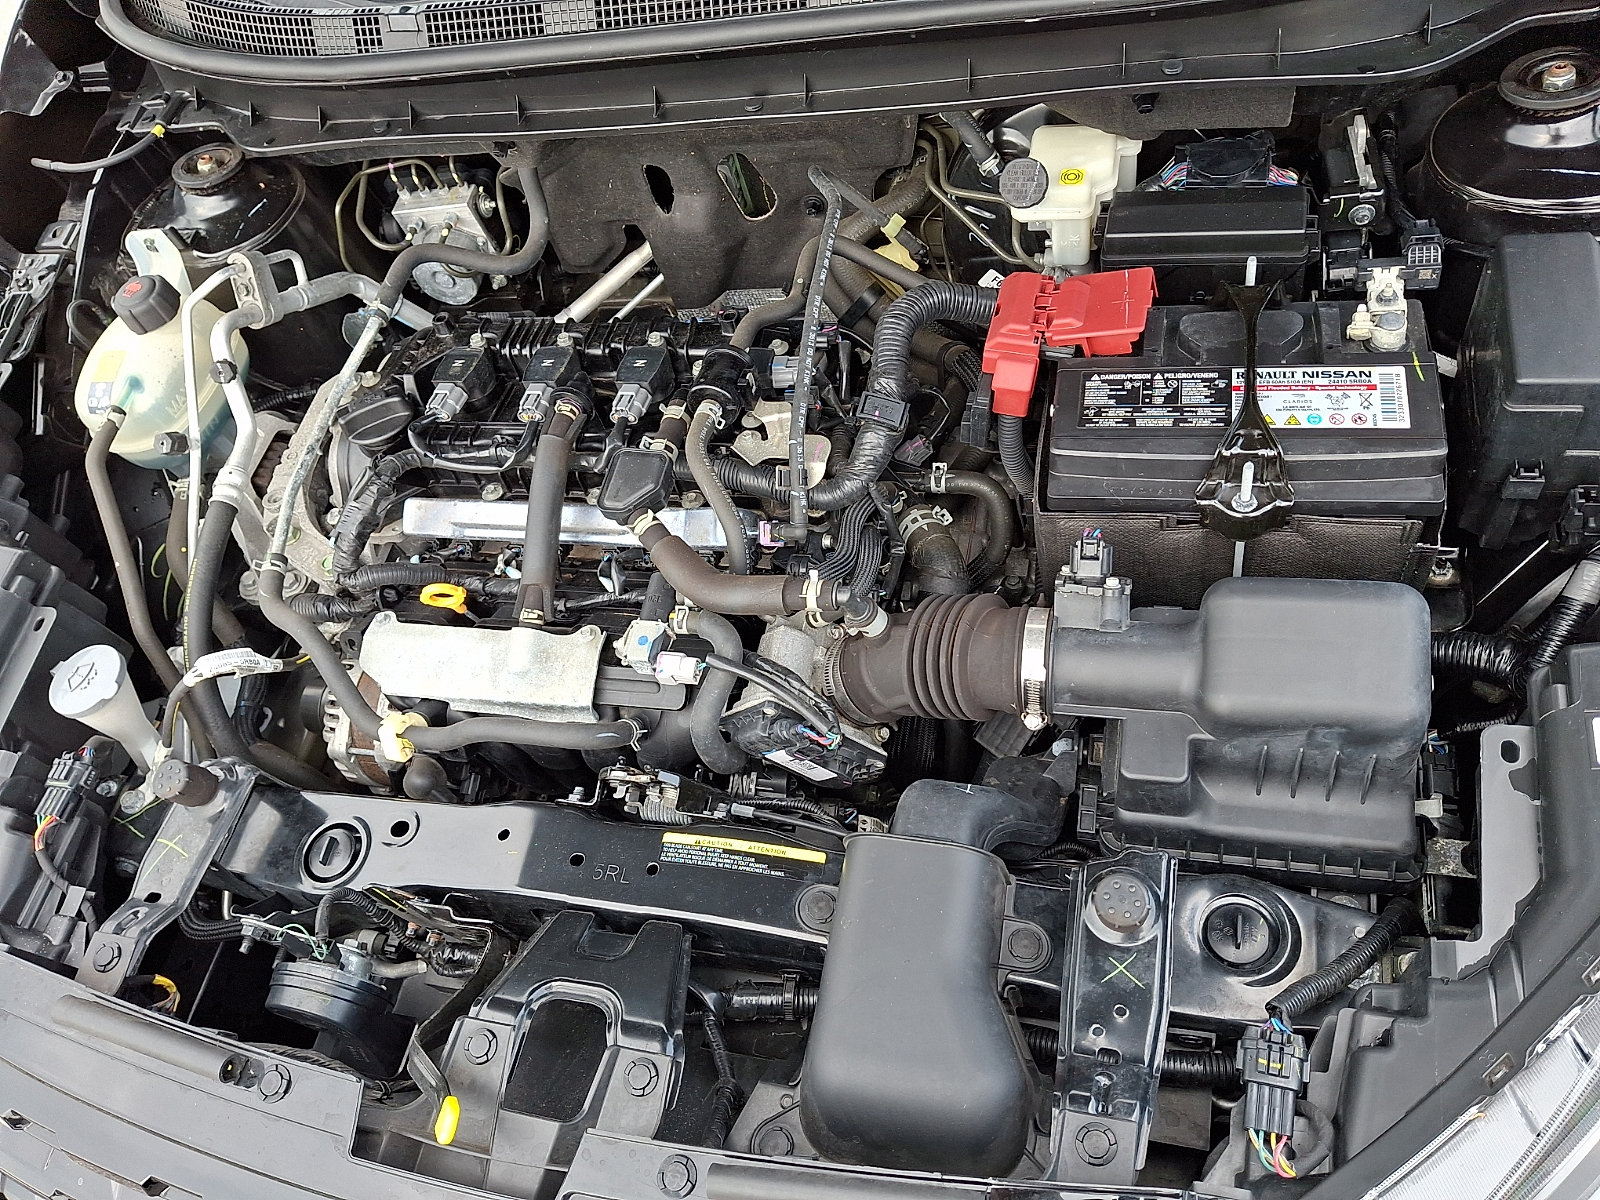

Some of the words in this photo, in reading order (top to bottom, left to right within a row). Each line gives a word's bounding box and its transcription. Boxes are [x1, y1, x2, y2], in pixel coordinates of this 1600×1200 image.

[1302, 370, 1372, 379] NISSAN
[701, 839, 733, 848] CAUTION
[748, 845, 787, 856] ATTENTION
[592, 863, 630, 884] 5RL
